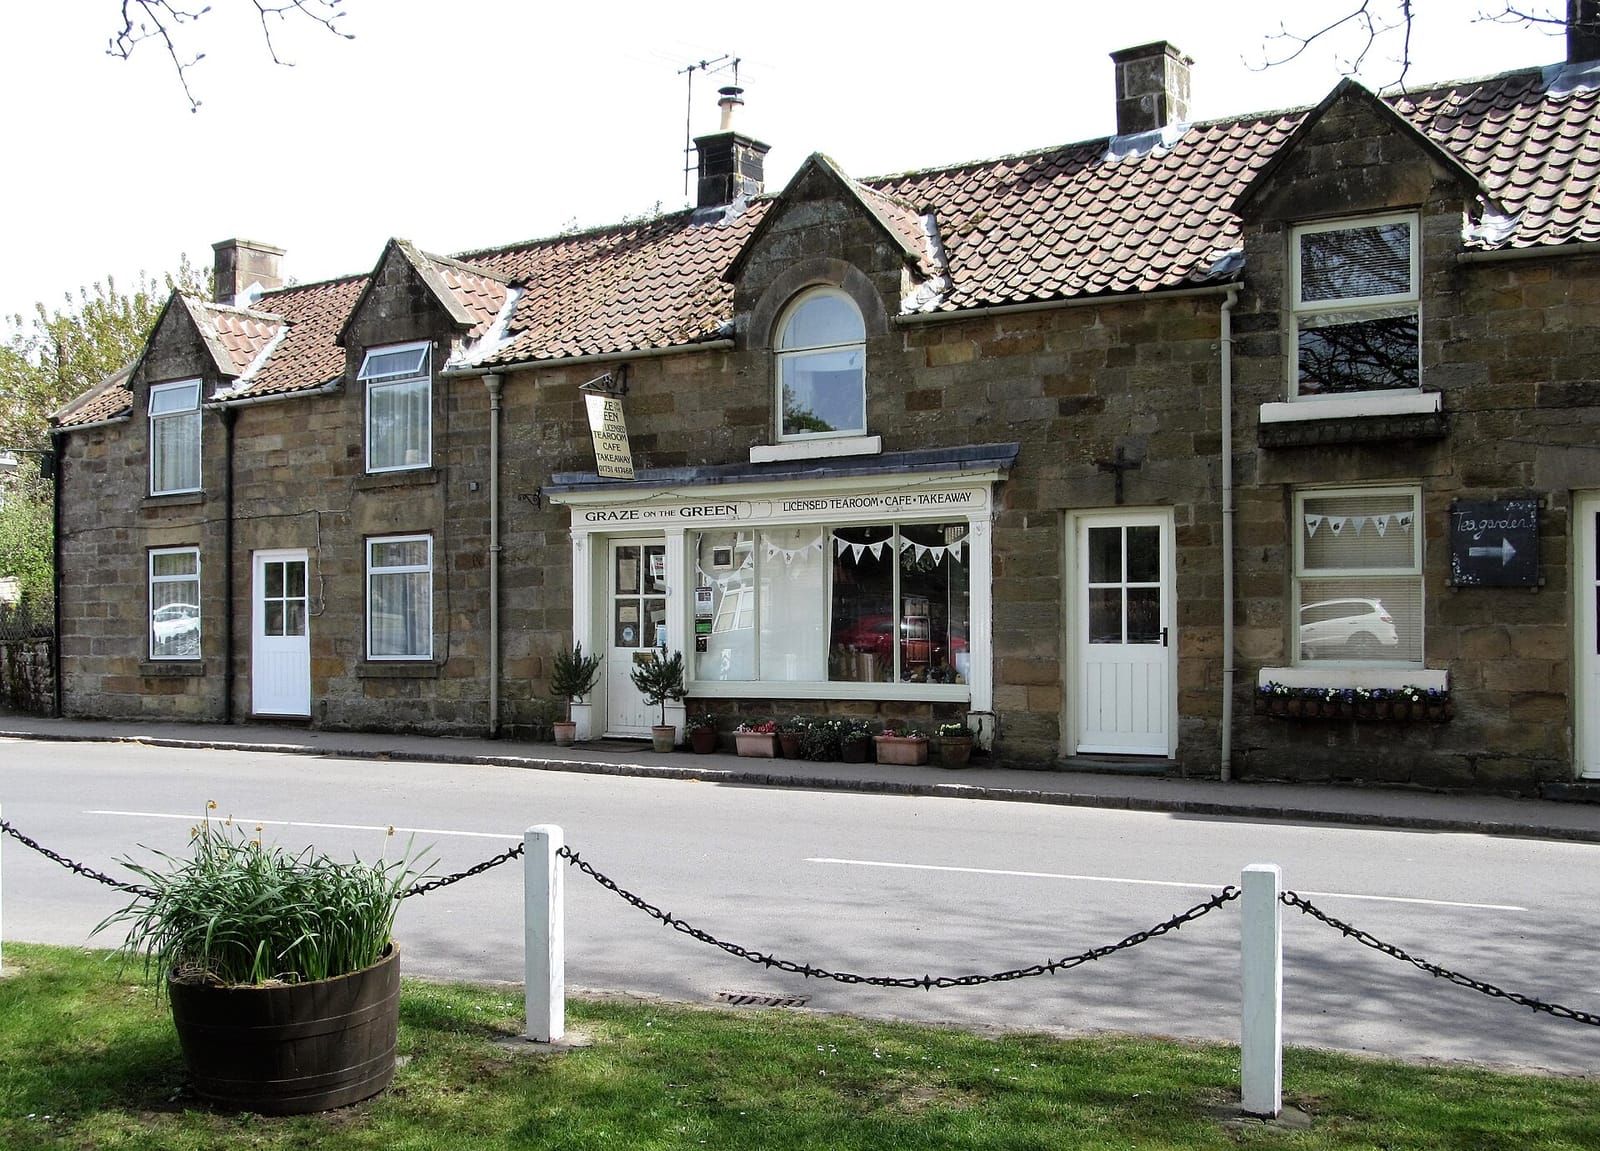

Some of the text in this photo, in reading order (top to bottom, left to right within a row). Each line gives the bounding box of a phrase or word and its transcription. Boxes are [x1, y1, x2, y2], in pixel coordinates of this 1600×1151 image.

[593, 430, 627, 442] TEAROOM
[602, 442, 622, 452] CAFE
[596, 453, 631, 464] TAKEAWAY
[783, 492, 972, 512] LICENSED TEAROOM CAFE TAKEAWAY
[585, 504, 738, 522] GRAZE ON THE GREEN
[1452, 511, 1529, 540] Tea garden
